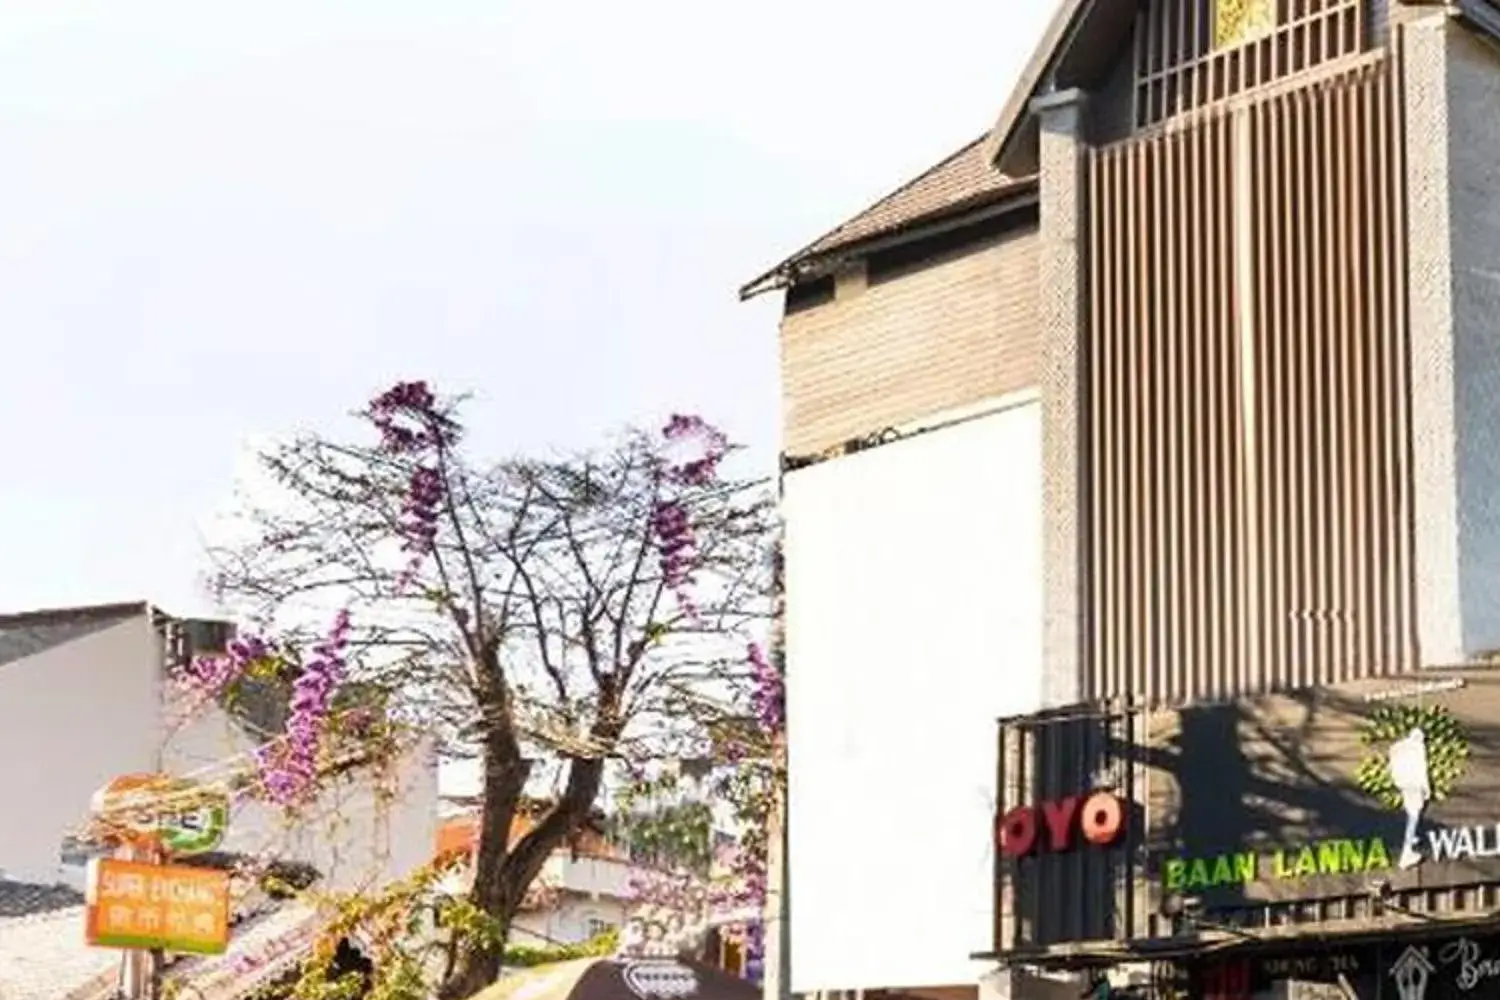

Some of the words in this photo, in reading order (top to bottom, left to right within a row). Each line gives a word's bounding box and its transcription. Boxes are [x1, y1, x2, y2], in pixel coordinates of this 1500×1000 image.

[996, 789, 1126, 857] OYO
[1165, 851, 1256, 890] BAAN
[1274, 837, 1391, 880] LANNA
